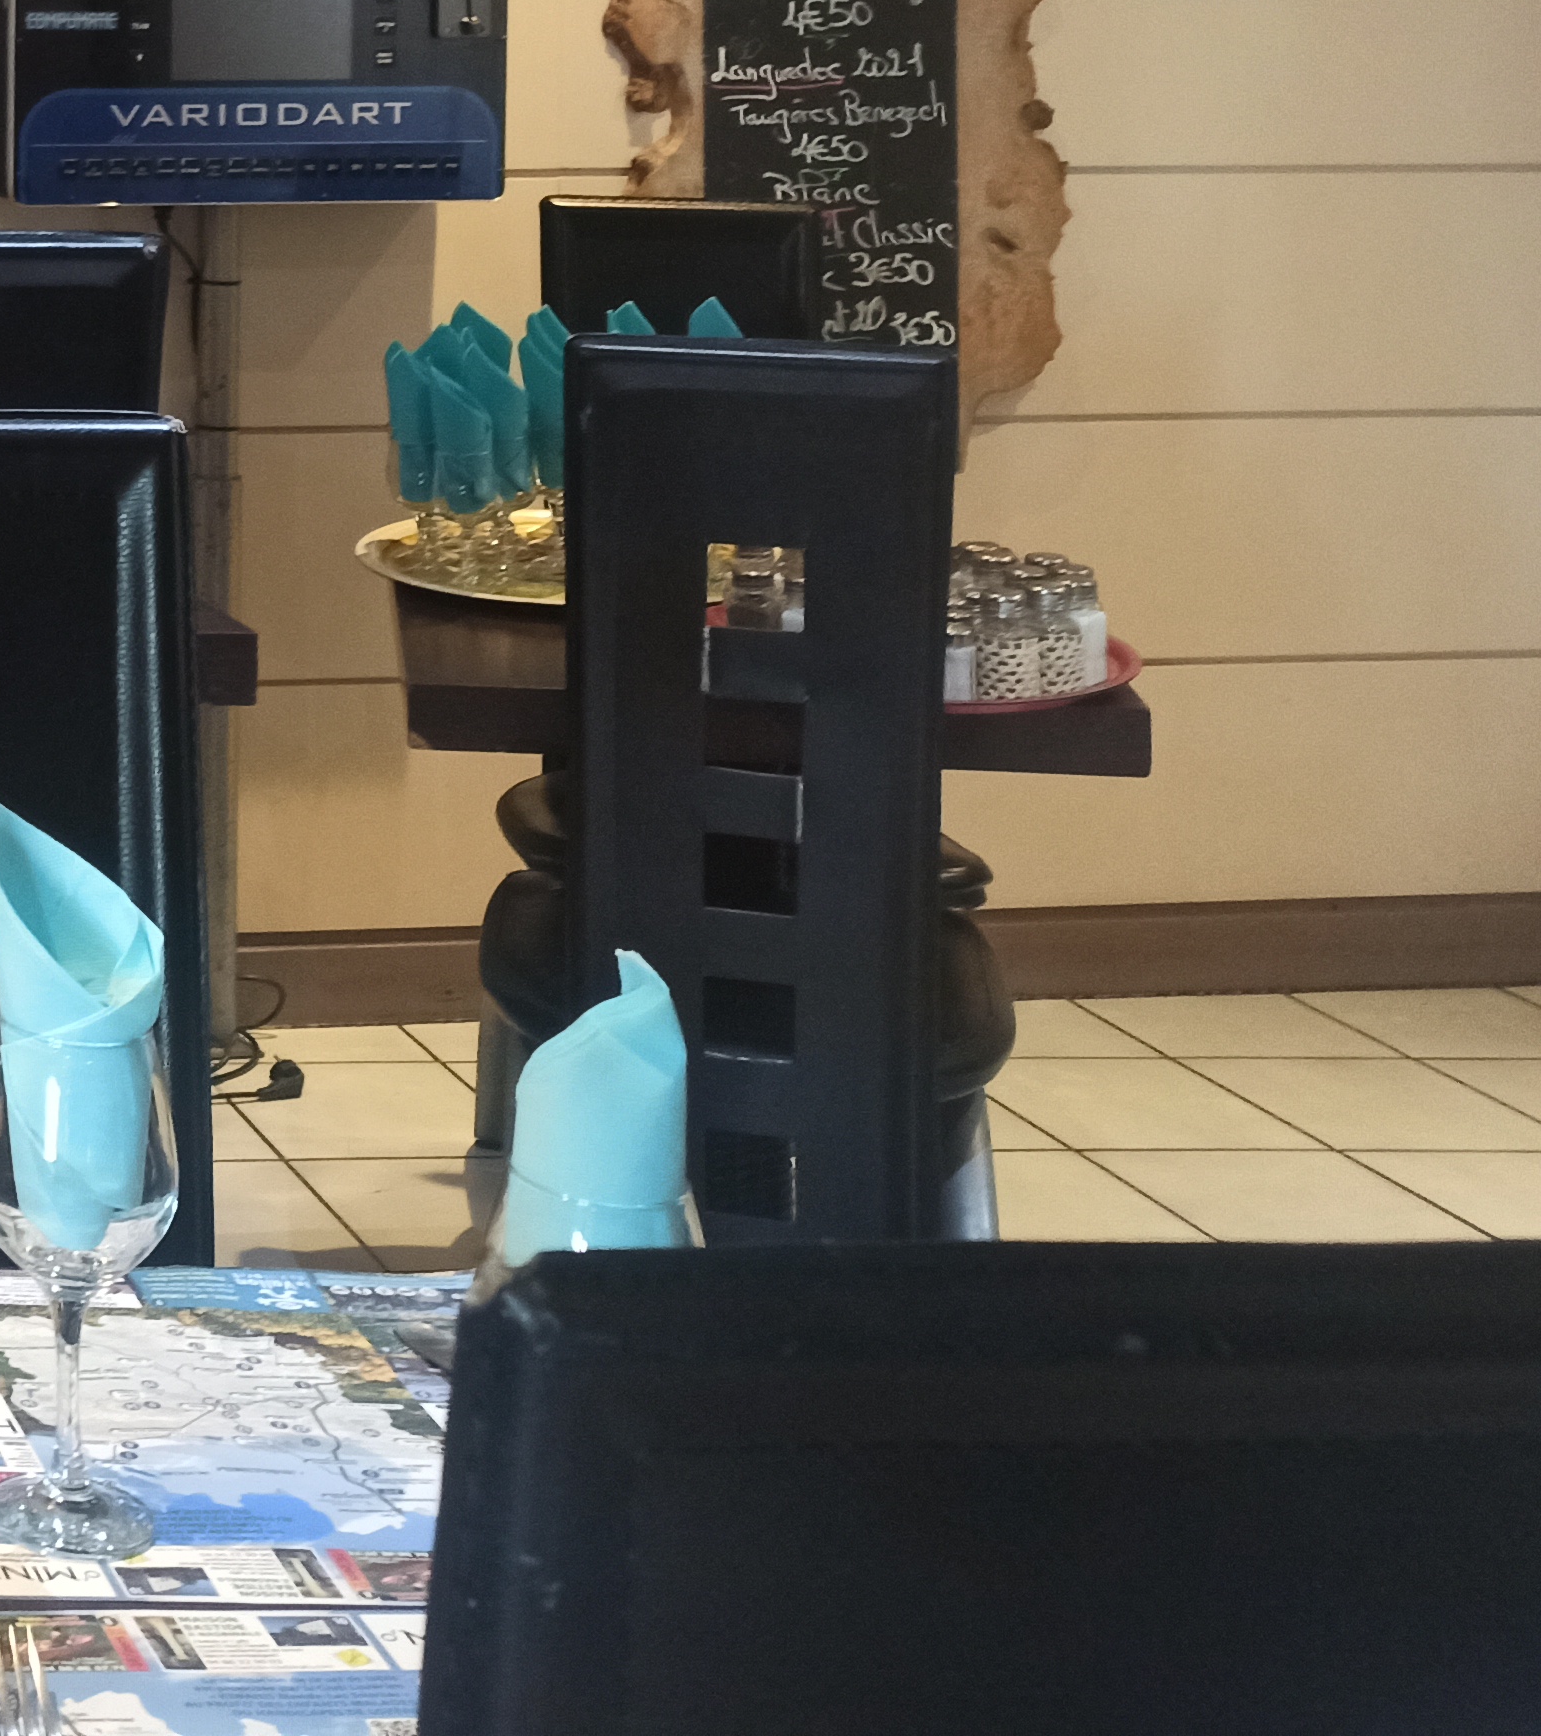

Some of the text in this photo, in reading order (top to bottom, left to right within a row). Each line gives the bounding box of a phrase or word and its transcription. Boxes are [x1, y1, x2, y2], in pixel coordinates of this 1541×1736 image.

[711, 46, 846, 101] Languedoc
[110, 100, 414, 128] VARIODART
[790, 132, 870, 163] 4€50
[762, 167, 881, 205] Blanc
[852, 209, 958, 250] Classic
[848, 251, 935, 288] 3€50
